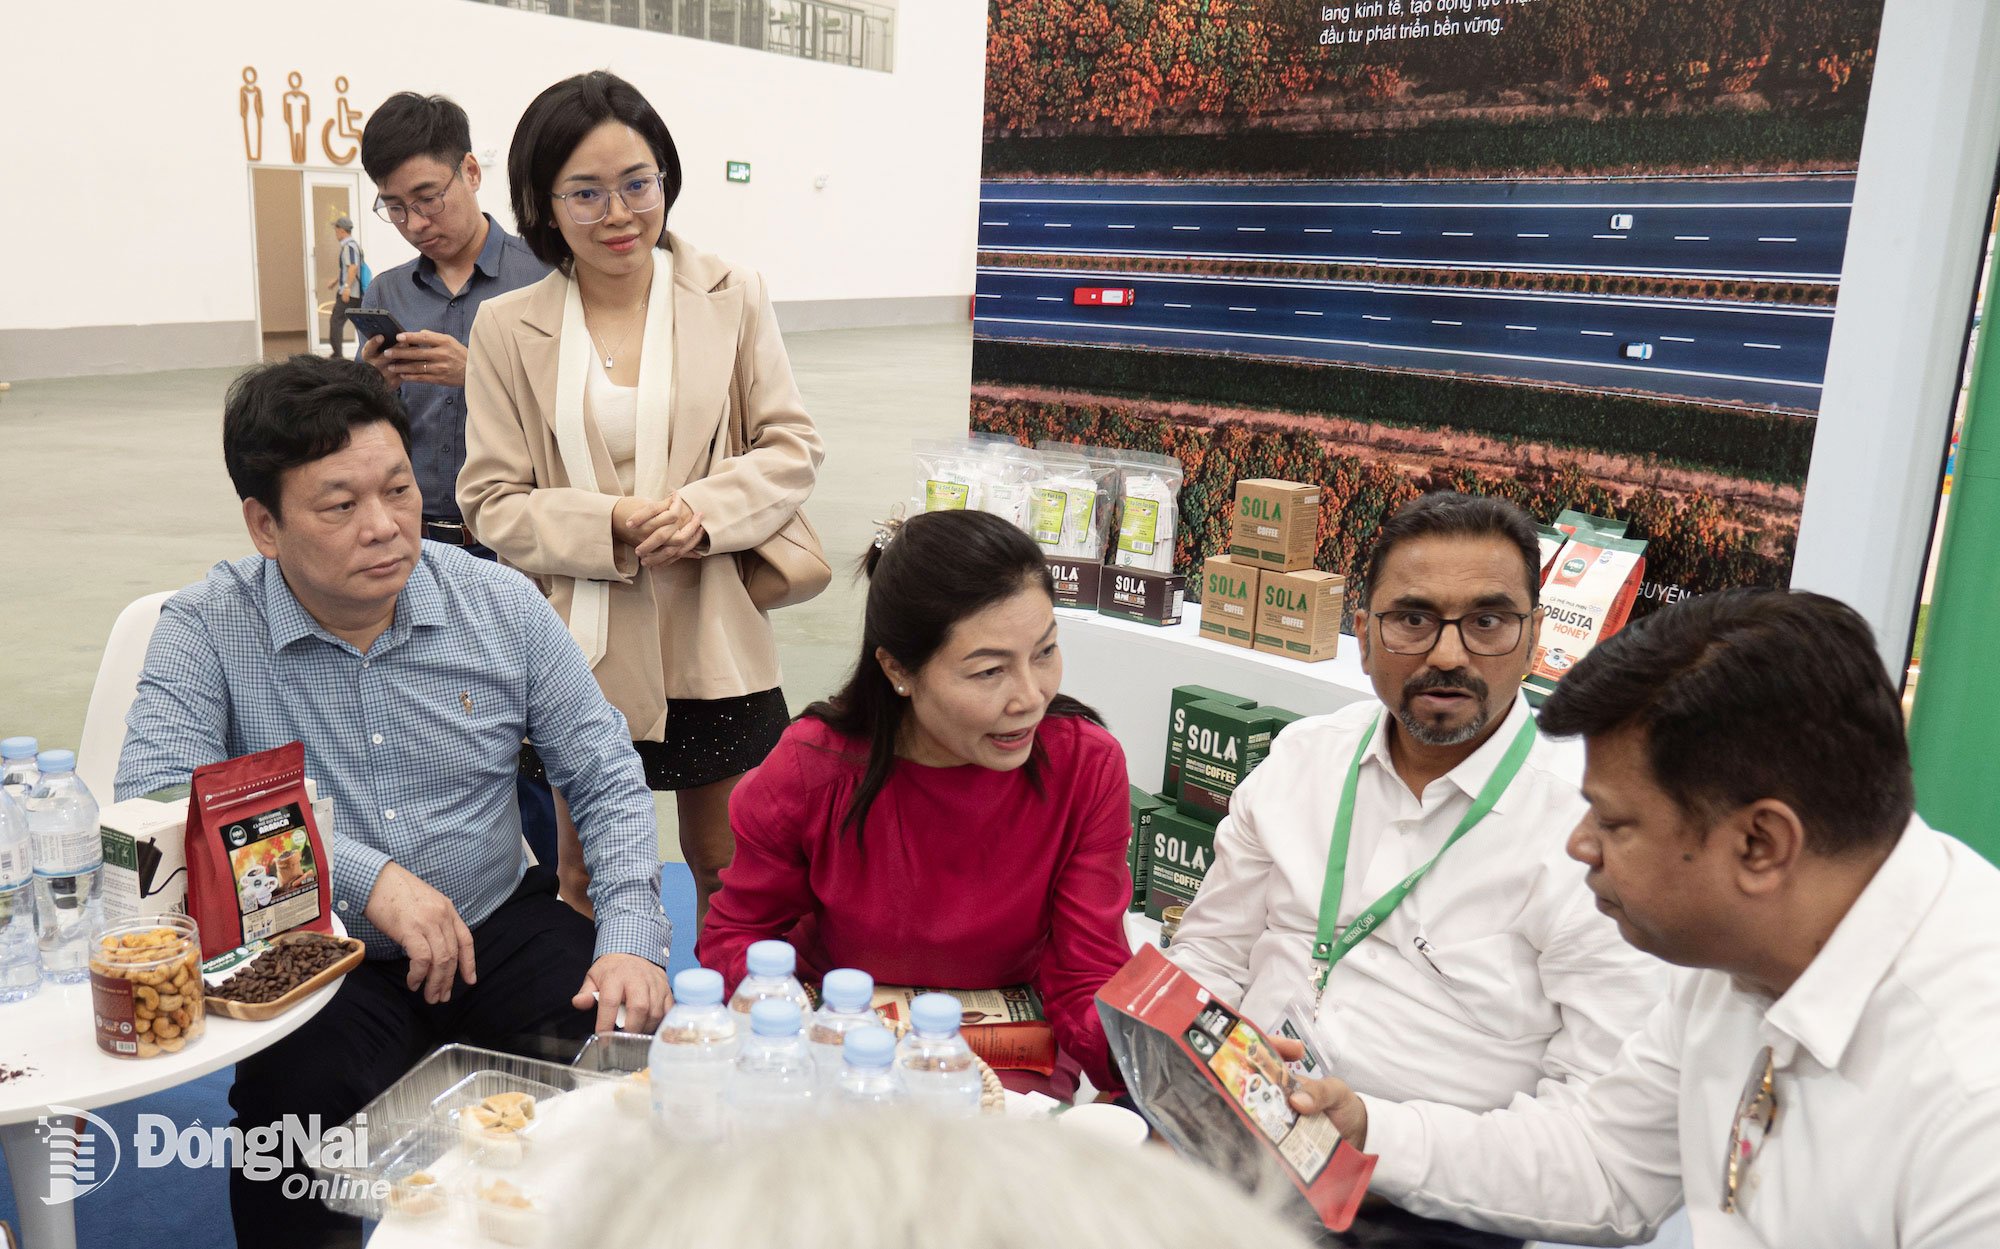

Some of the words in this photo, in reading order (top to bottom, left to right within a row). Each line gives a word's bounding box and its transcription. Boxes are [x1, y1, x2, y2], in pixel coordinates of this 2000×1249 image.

[1321, 6, 1350, 24] lang
[1354, 1, 1383, 19] kinh
[1409, 0, 1432, 16] tạo
[1319, 25, 1345, 45] đầu
[1348, 28, 1363, 42] tư
[1365, 24, 1397, 45] phát
[1399, 18, 1430, 39] triển
[1433, 15, 1460, 36] bền
[1464, 17, 1504, 36] vững.
[1240, 495, 1282, 522] SOLA
[1256, 526, 1279, 538] COFFEE
[1115, 575, 1146, 595] SOLA
[1209, 573, 1248, 599] SOLA
[1223, 603, 1244, 615] COFFEE
[1265, 585, 1308, 613] SOLA
[1281, 615, 1304, 628] COFFEE
[1553, 622, 1589, 640] HONEY
[1187, 725, 1238, 764] SOLA
[1205, 764, 1237, 785] COFFEE
[258, 818, 290, 835] ARABICA
[1141, 815, 1151, 825] SO
[1154, 833, 1206, 872] SOLA
[1173, 872, 1201, 890] COFFE
